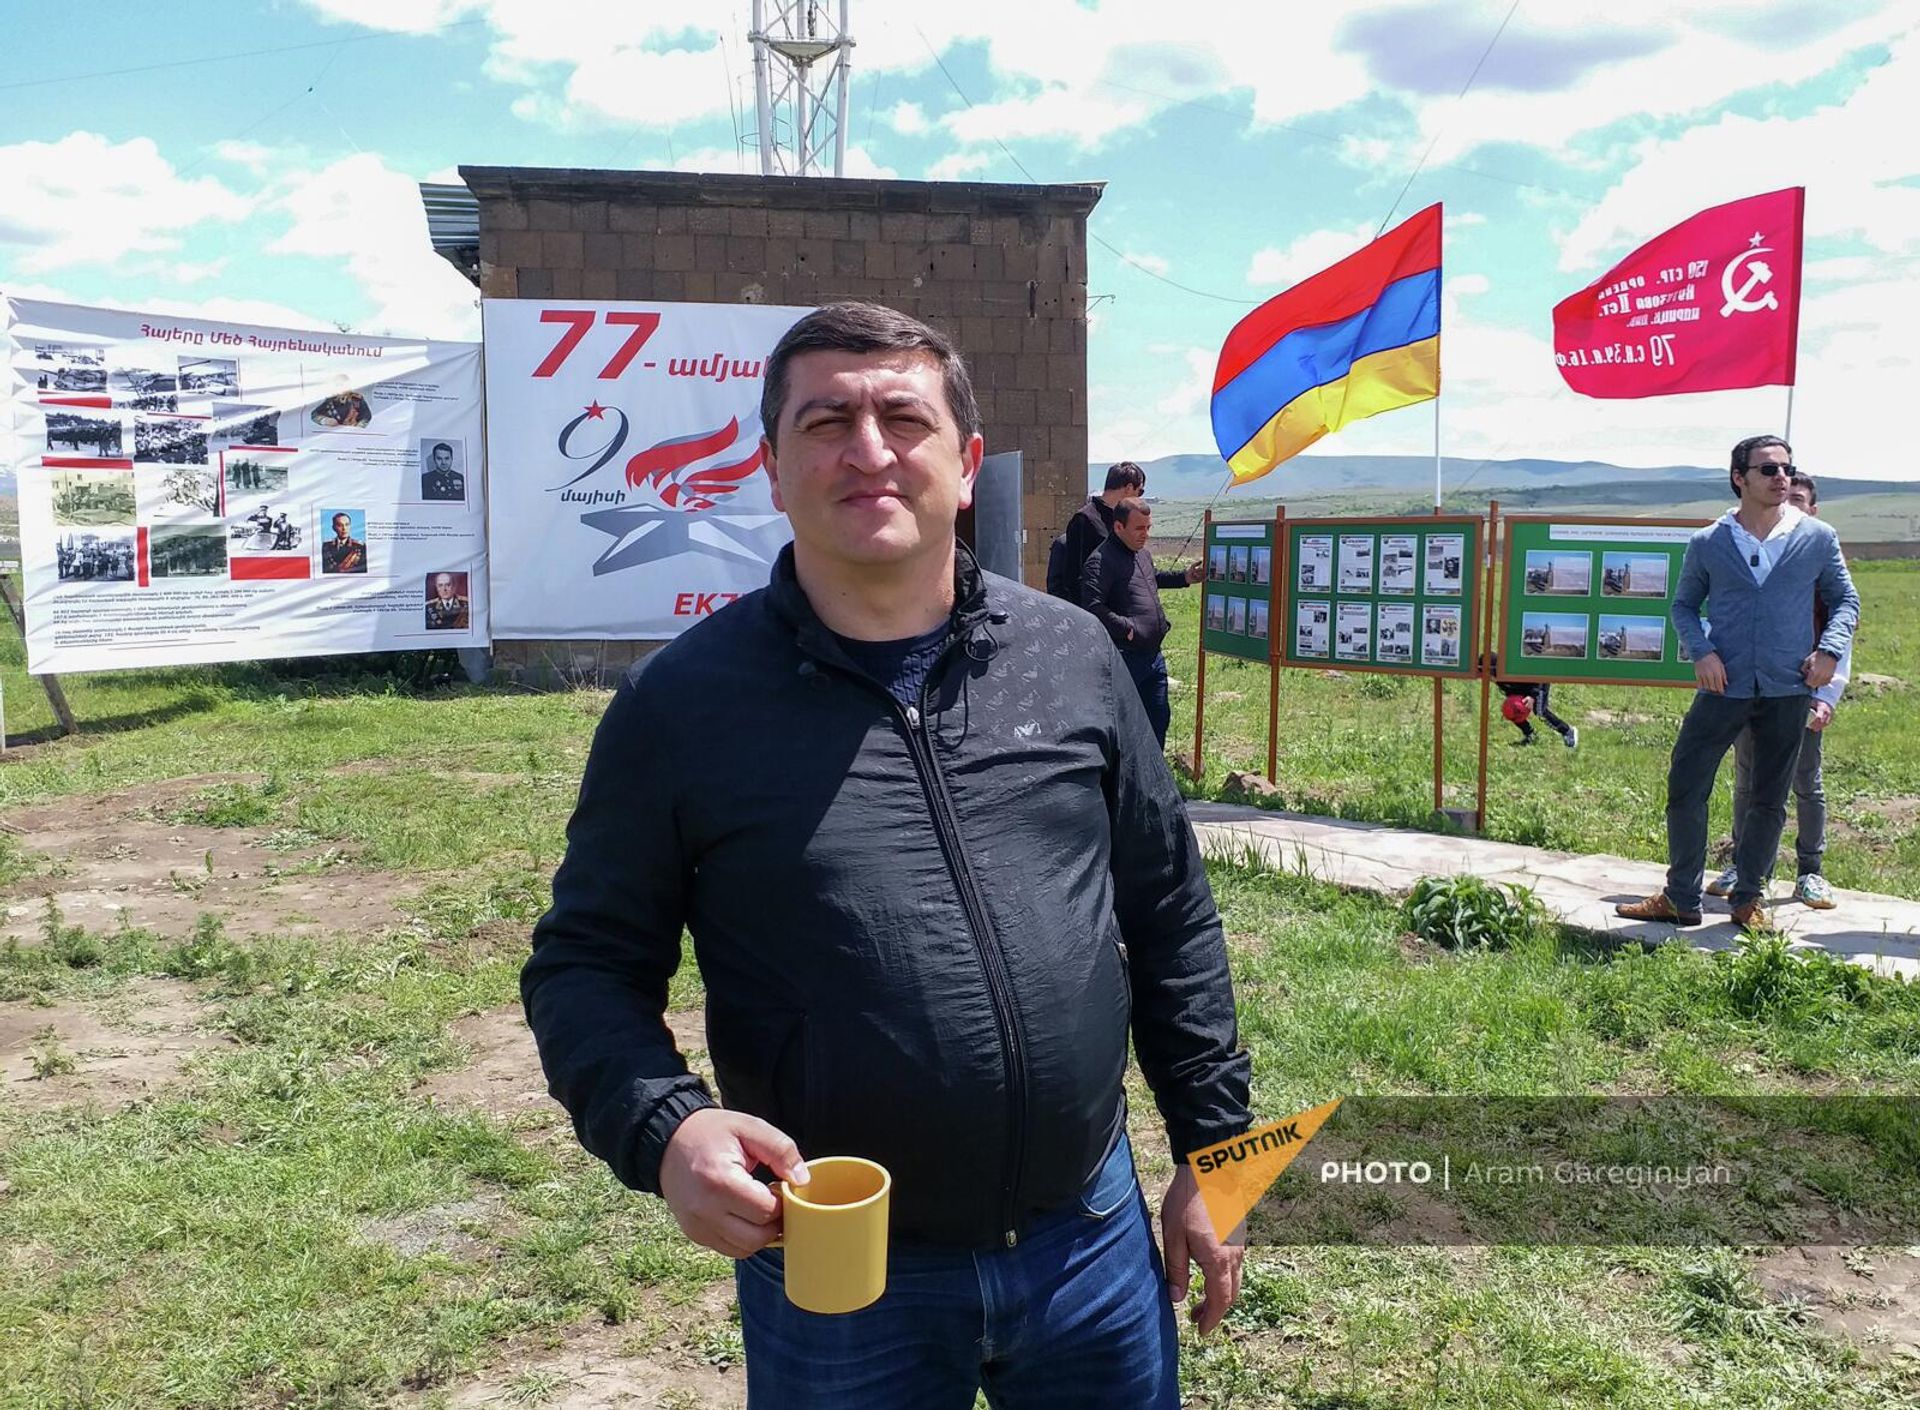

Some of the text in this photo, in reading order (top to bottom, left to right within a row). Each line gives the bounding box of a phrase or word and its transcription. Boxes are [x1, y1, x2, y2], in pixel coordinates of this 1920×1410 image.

[140, 323, 203, 346] Հայերը
[209, 330, 243, 346] Մեծ
[668, 352, 770, 382] ամյա
[544, 404, 629, 492] 9
[561, 489, 626, 505] մայիսի
